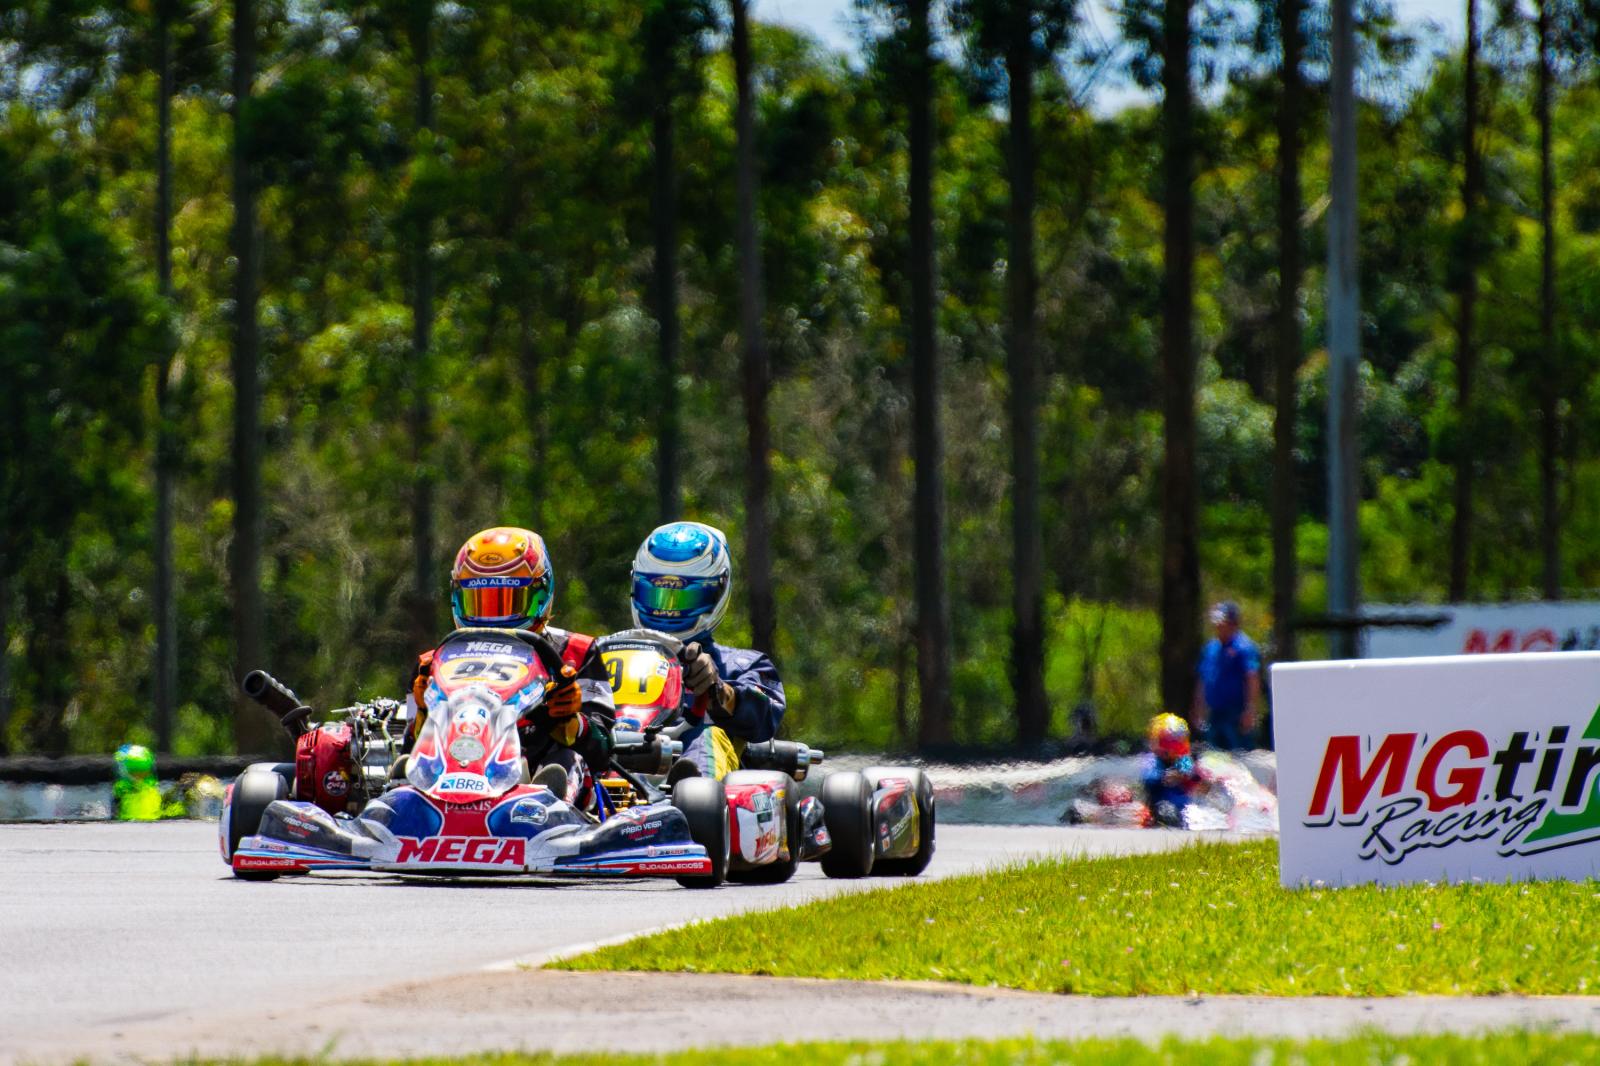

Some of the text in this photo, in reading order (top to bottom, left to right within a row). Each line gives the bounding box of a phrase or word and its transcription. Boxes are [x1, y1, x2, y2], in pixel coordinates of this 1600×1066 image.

[465, 641, 513, 655] MEGA
[449, 661, 518, 682] 95
[455, 778, 485, 791] BRB
[1361, 796, 1549, 855] Racing
[396, 838, 525, 865] MEGA
